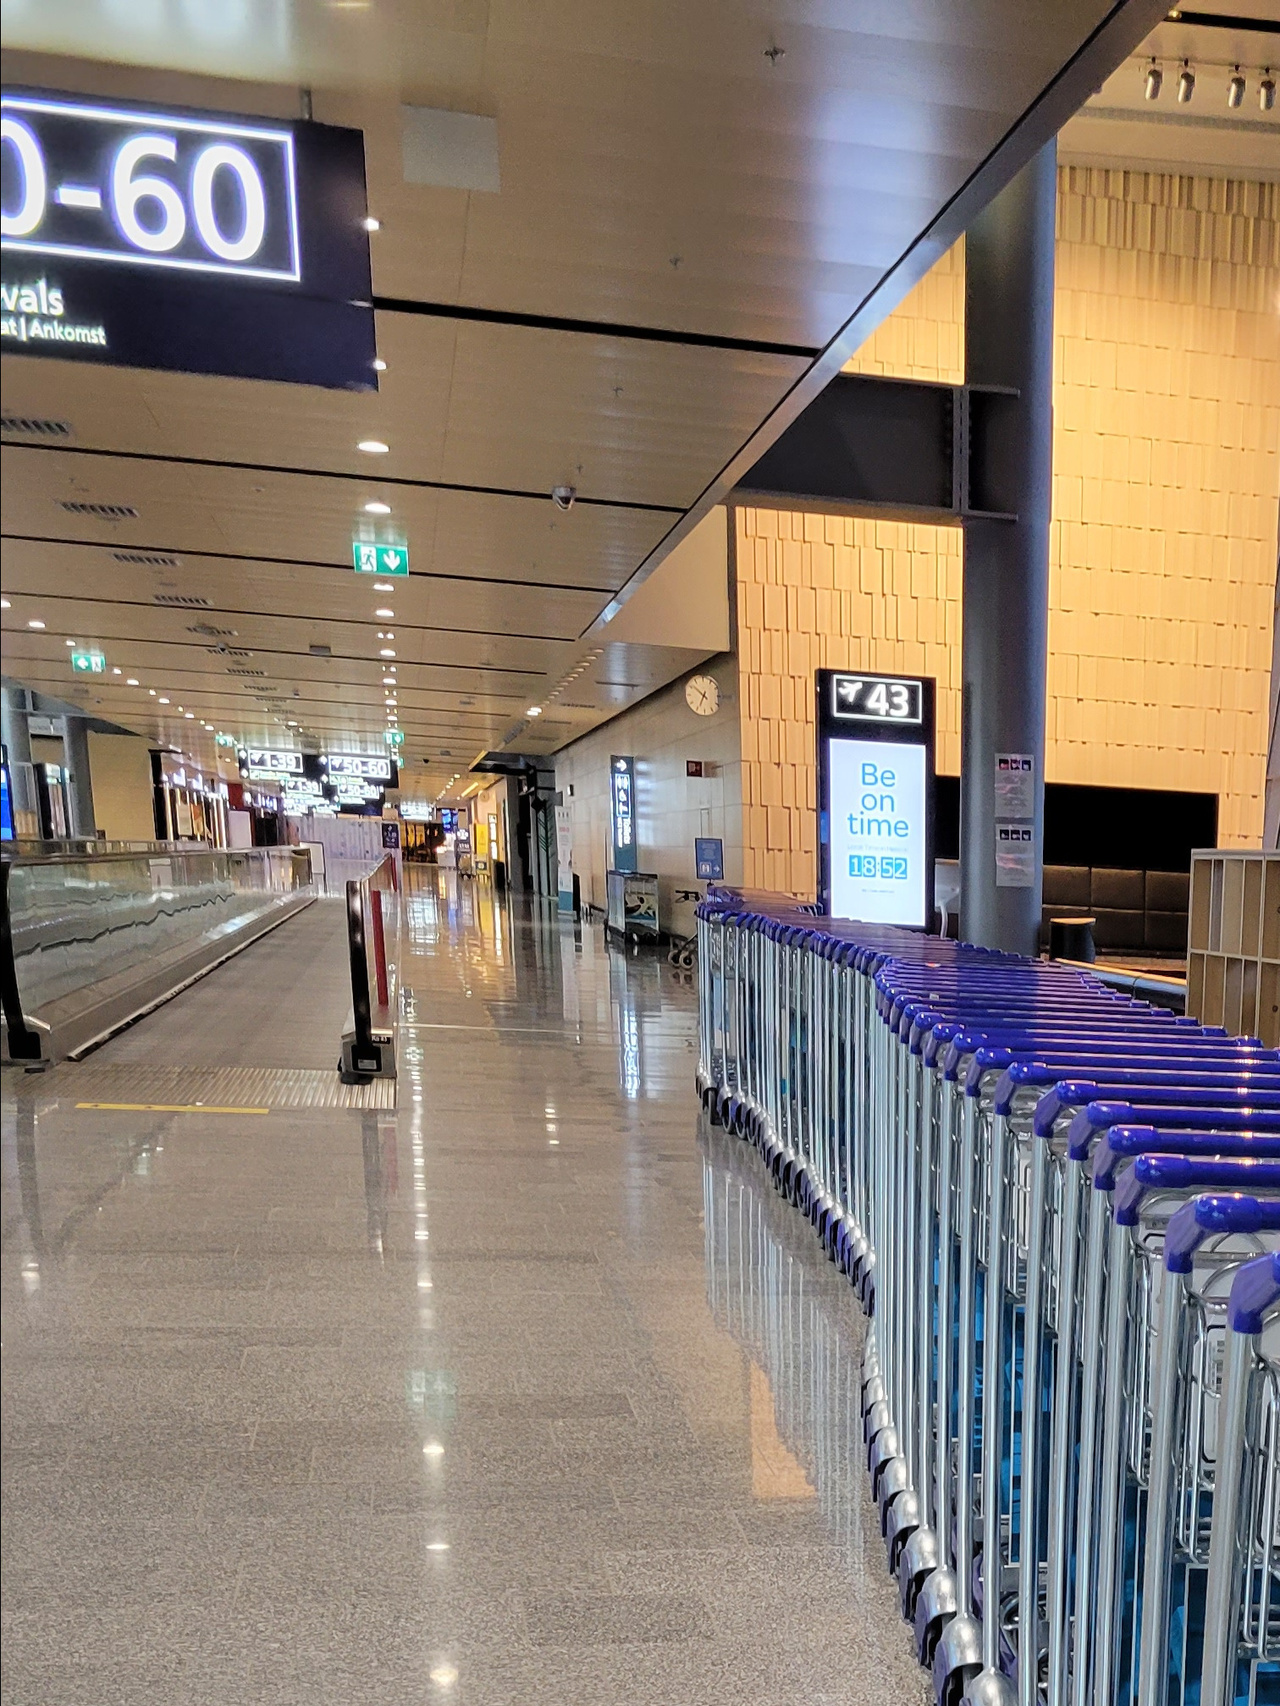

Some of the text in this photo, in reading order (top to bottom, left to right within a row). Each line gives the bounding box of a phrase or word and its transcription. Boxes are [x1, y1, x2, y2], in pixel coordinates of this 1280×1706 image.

[30, 318, 107, 346] Ankomst
[866, 683, 909, 717] 43
[344, 759, 388, 777] 50-60
[861, 763, 896, 788] Be
[861, 793, 895, 812] on
[847, 811, 909, 838] time
[849, 855, 907, 879] 18:52
